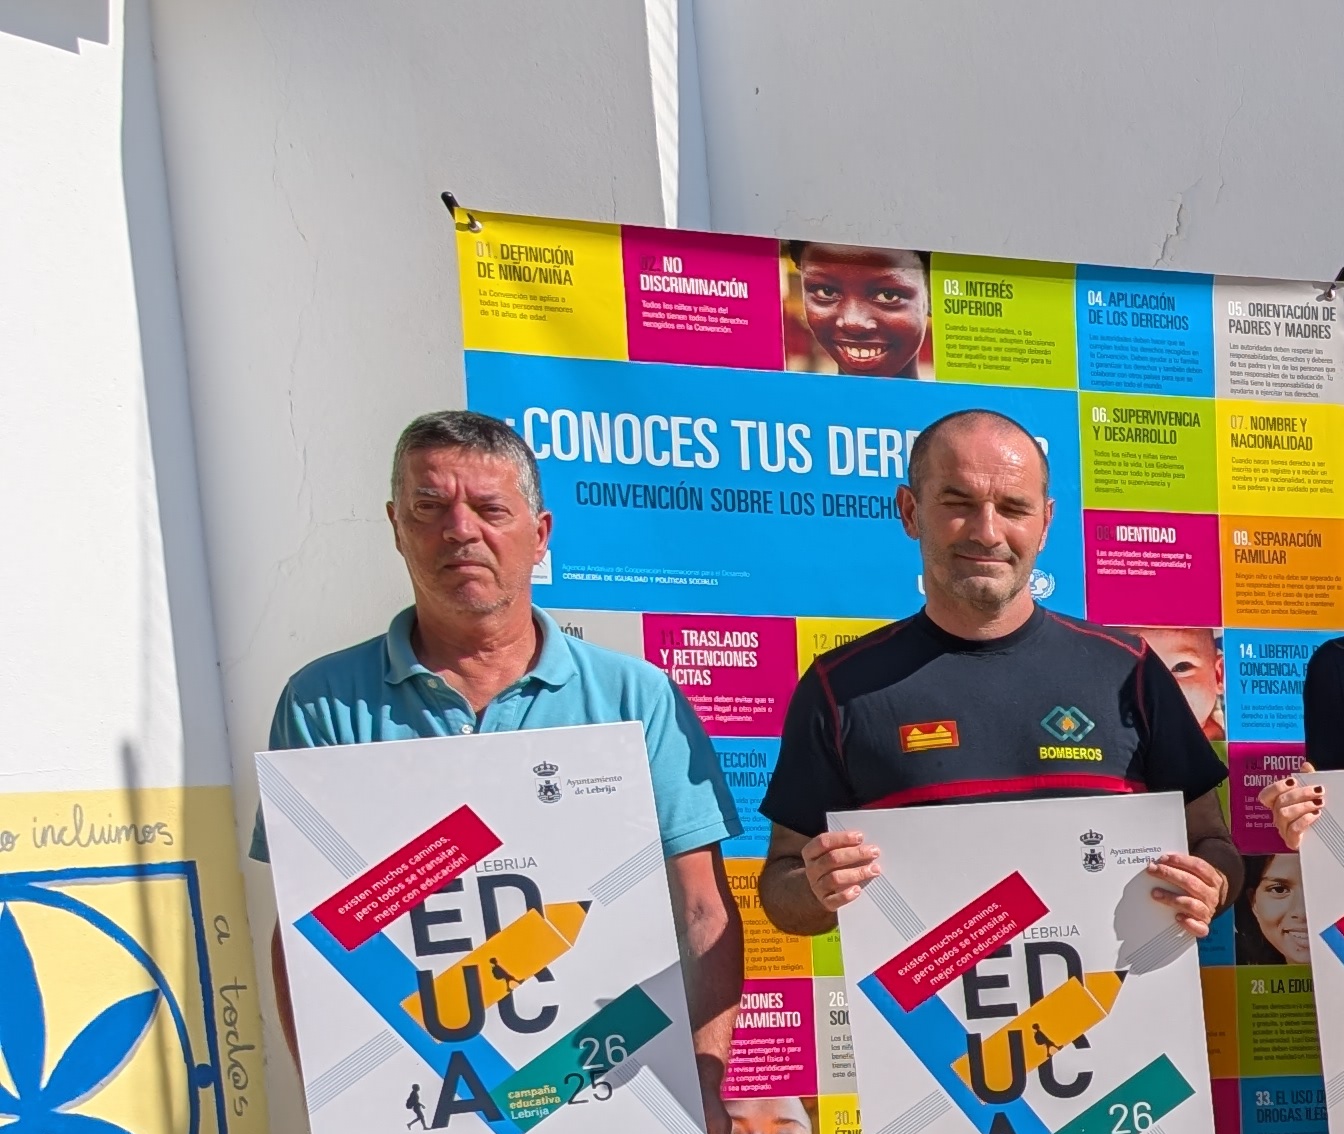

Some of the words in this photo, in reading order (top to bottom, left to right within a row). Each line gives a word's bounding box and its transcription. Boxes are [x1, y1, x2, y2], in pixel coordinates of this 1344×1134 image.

[500, 243, 575, 267] DEFINICIÓN
[663, 256, 683, 274] NO
[477, 261, 495, 279] DE
[499, 261, 573, 287] NIÑO/NIÑA
[640, 274, 749, 299] DISCRIMINACIÓN
[943, 278, 964, 296] 03.
[965, 279, 1014, 299] INTERÉS
[943, 299, 1003, 317] SUPERIOR
[1088, 290, 1106, 307] 04.
[1108, 290, 1176, 312] APLICACIÓN
[1228, 300, 1247, 318] 05.
[1248, 300, 1319, 321] ORIENTACIÓN
[1322, 306, 1337, 322] DE
[1088, 309, 1103, 325] DE
[1105, 310, 1125, 327] LOS
[1127, 312, 1190, 331] DERECHOS
[1228, 319, 1272, 337] PADRES
[1273, 321, 1284, 338] Y
[1284, 321, 1332, 340] MADRES
[1092, 406, 1110, 424] 06.
[1112, 407, 1201, 428] SUPERVIVENCIA
[1249, 415, 1297, 433] NOMBRE
[1298, 417, 1307, 433] Y
[1092, 426, 1101, 442] Y
[1103, 426, 1177, 445] DESARROLLO
[1230, 432, 1313, 451] NACIONALIDAD
[731, 418, 813, 476] TUS
[575, 479, 704, 513] CONVENCIÓN
[710, 487, 774, 516] SOBRE
[780, 490, 815, 518] LOS
[1116, 525, 1177, 544] IDENTIDAD
[1233, 529, 1252, 546] 09.
[1253, 527, 1322, 548] SEPARACIÓN
[1234, 547, 1287, 565] FAMILIAR
[681, 630, 759, 649] TRASLADOS
[660, 649, 671, 665] Y
[674, 650, 758, 668] RETENCIONES
[1239, 642, 1257, 659] 14.
[1259, 643, 1309, 660] LIBERTAD
[1039, 746, 1103, 762] BOMBEROS
[32, 804, 174, 850] incluimos
[474, 856, 537, 874] LEBRIJA
[337, 888, 373, 915] existen
[371, 863, 409, 891] muchos
[353, 901, 379, 922] ¡pero
[378, 882, 406, 903] todos
[405, 873, 418, 885] se
[416, 844, 460, 876] transitan
[373, 900, 401, 923] mejor
[401, 887, 421, 902] con
[420, 853, 469, 890] educación!
[214, 914, 231, 945] a
[1022, 924, 1080, 940] LEBRIJA
[220, 976, 256, 1118] tod@s
[579, 1034, 628, 1069] 26
[432, 1051, 505, 1128] A
[507, 1084, 557, 1099] campaña
[564, 1069, 613, 1105] 25
[509, 1096, 561, 1109] educativa
[511, 1107, 549, 1120] Lebrija
